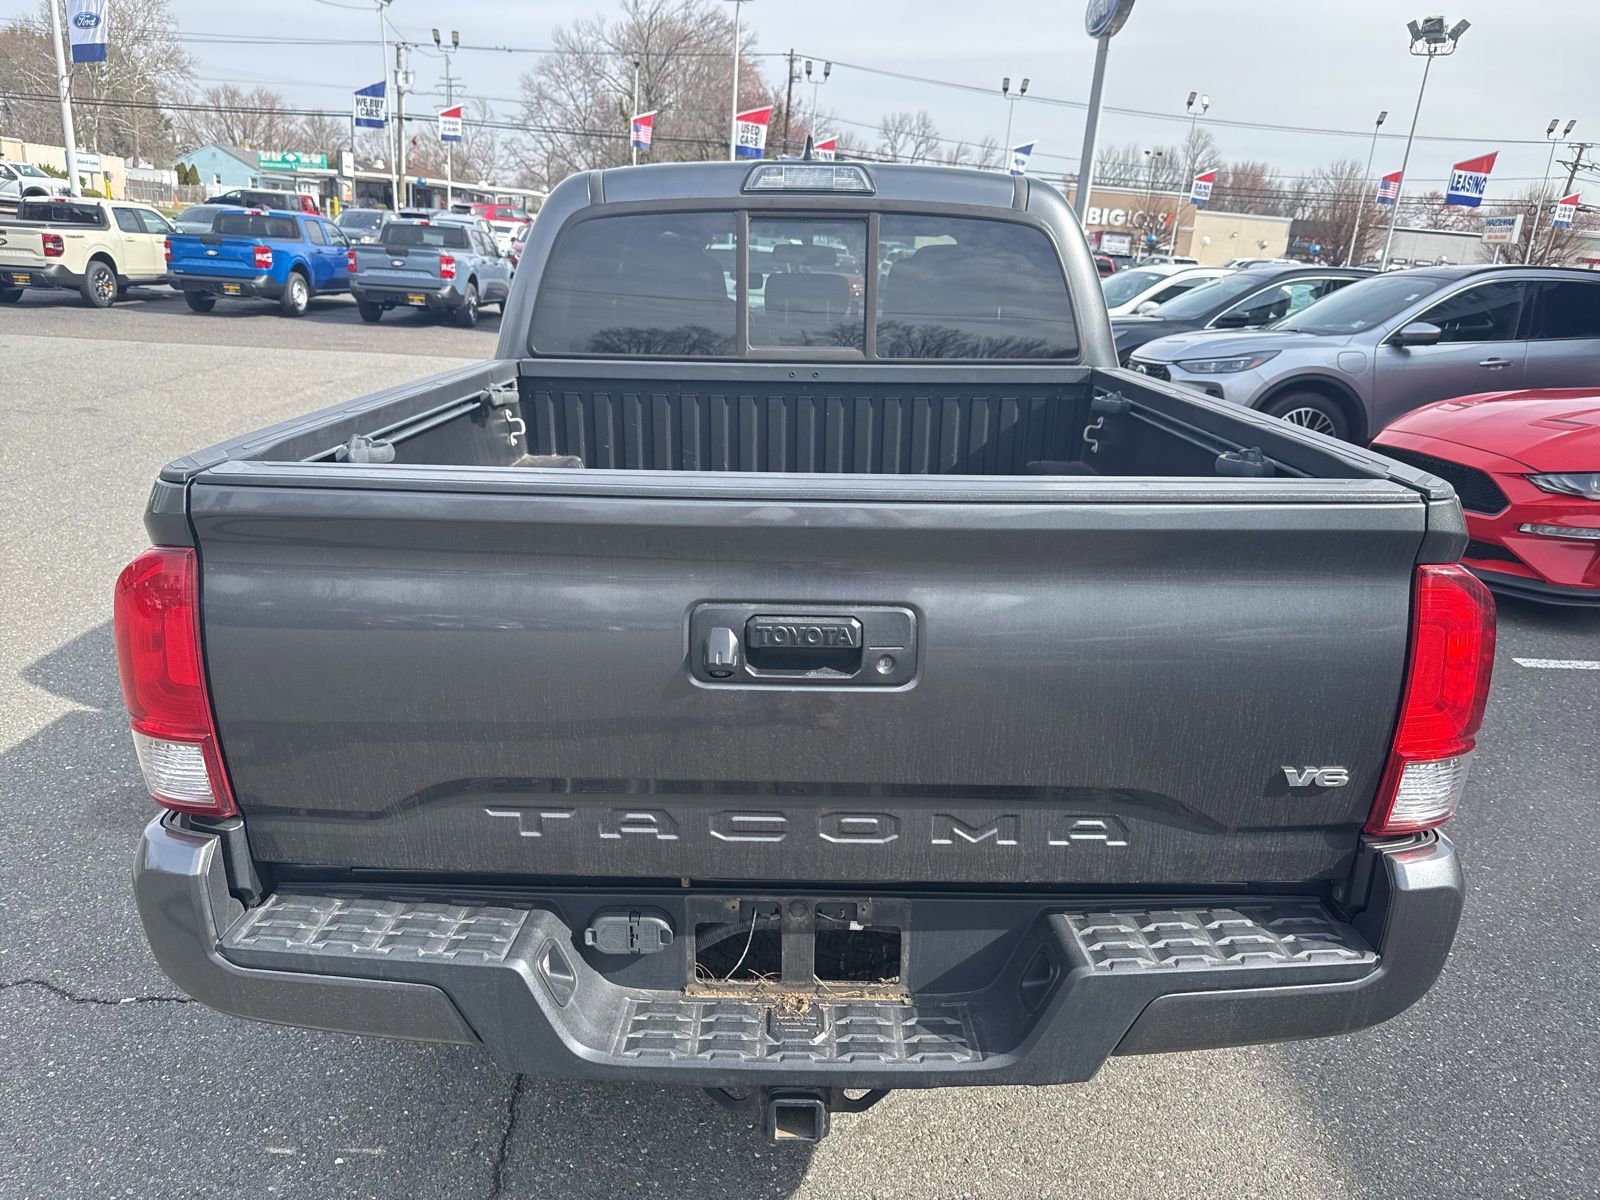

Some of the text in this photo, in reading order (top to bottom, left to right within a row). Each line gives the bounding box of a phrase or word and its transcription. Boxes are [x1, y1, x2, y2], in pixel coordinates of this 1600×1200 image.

[77, 14, 97, 26] Ford
[355, 97, 384, 109] WE BUY
[360, 107, 380, 118] CARS
[740, 122, 760, 135] USED
[740, 134, 759, 147] CARS
[1450, 172, 1488, 195] LEASING
[1086, 206, 1127, 227] BIG
[756, 625, 854, 647] TOYOTA
[1280, 765, 1349, 787] V6
[484, 805, 1128, 846] TACOMA
